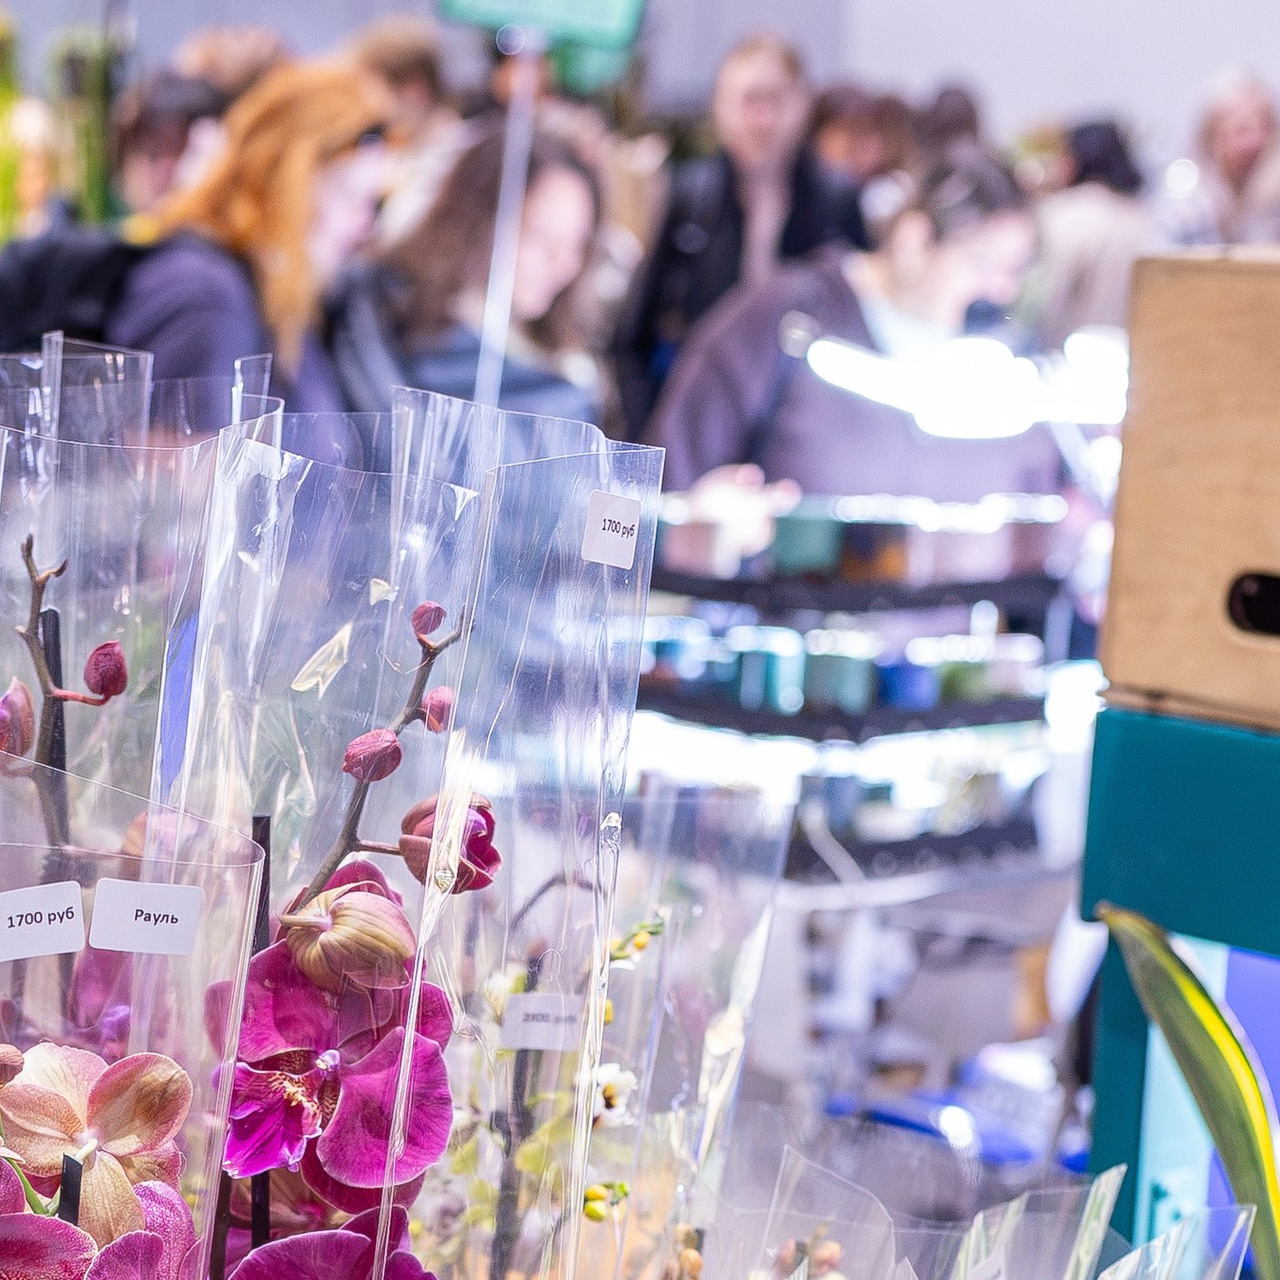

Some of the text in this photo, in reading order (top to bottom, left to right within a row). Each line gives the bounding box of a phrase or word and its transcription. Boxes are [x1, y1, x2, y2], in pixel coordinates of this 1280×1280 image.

[601, 518, 635, 539] 1700 руб
[7, 907, 75, 929] 1700 руб
[134, 909, 179, 926] Рауль
